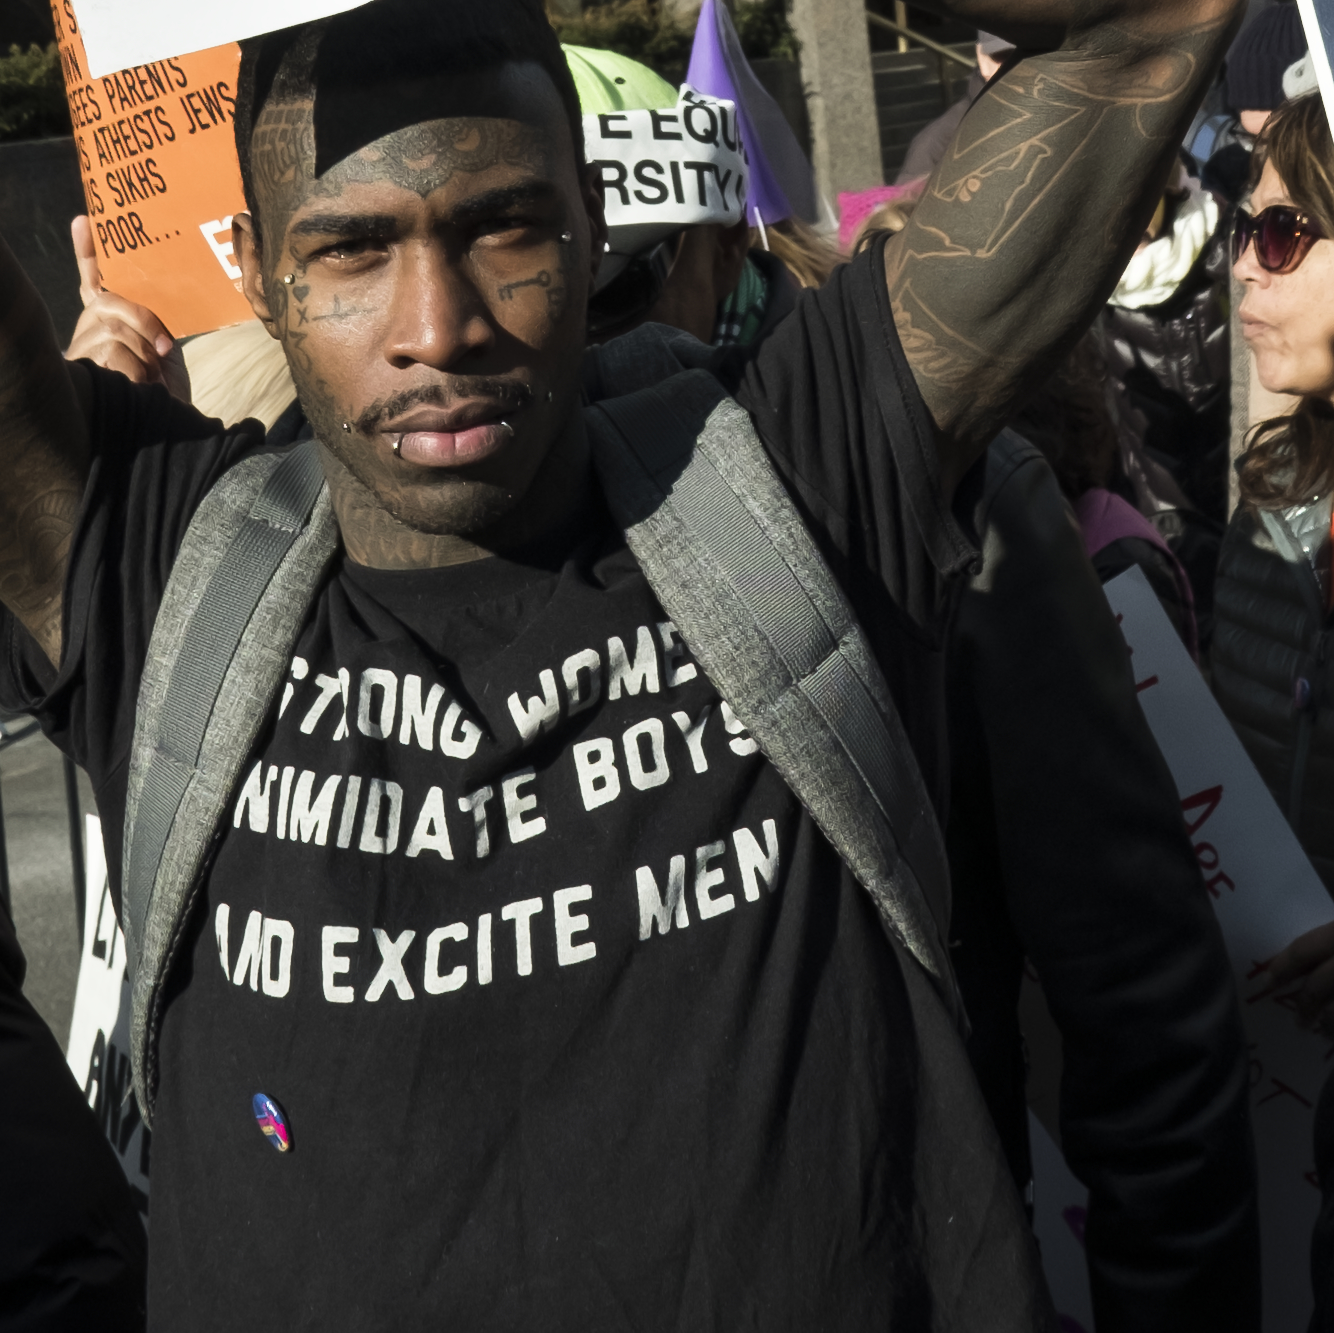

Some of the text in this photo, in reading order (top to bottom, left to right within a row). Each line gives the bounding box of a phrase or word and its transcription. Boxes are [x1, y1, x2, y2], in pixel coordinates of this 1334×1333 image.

[92, 106, 177, 168] ATHEISTS
[178, 81, 237, 135] JEWS
[103, 57, 189, 115] PARENTS
[105, 157, 168, 209] SIKHS
[507, 622, 699, 742] WOME
[573, 700, 762, 812] BOYS
[321, 883, 597, 1004] EXCITE
[635, 818, 780, 942] MEN
